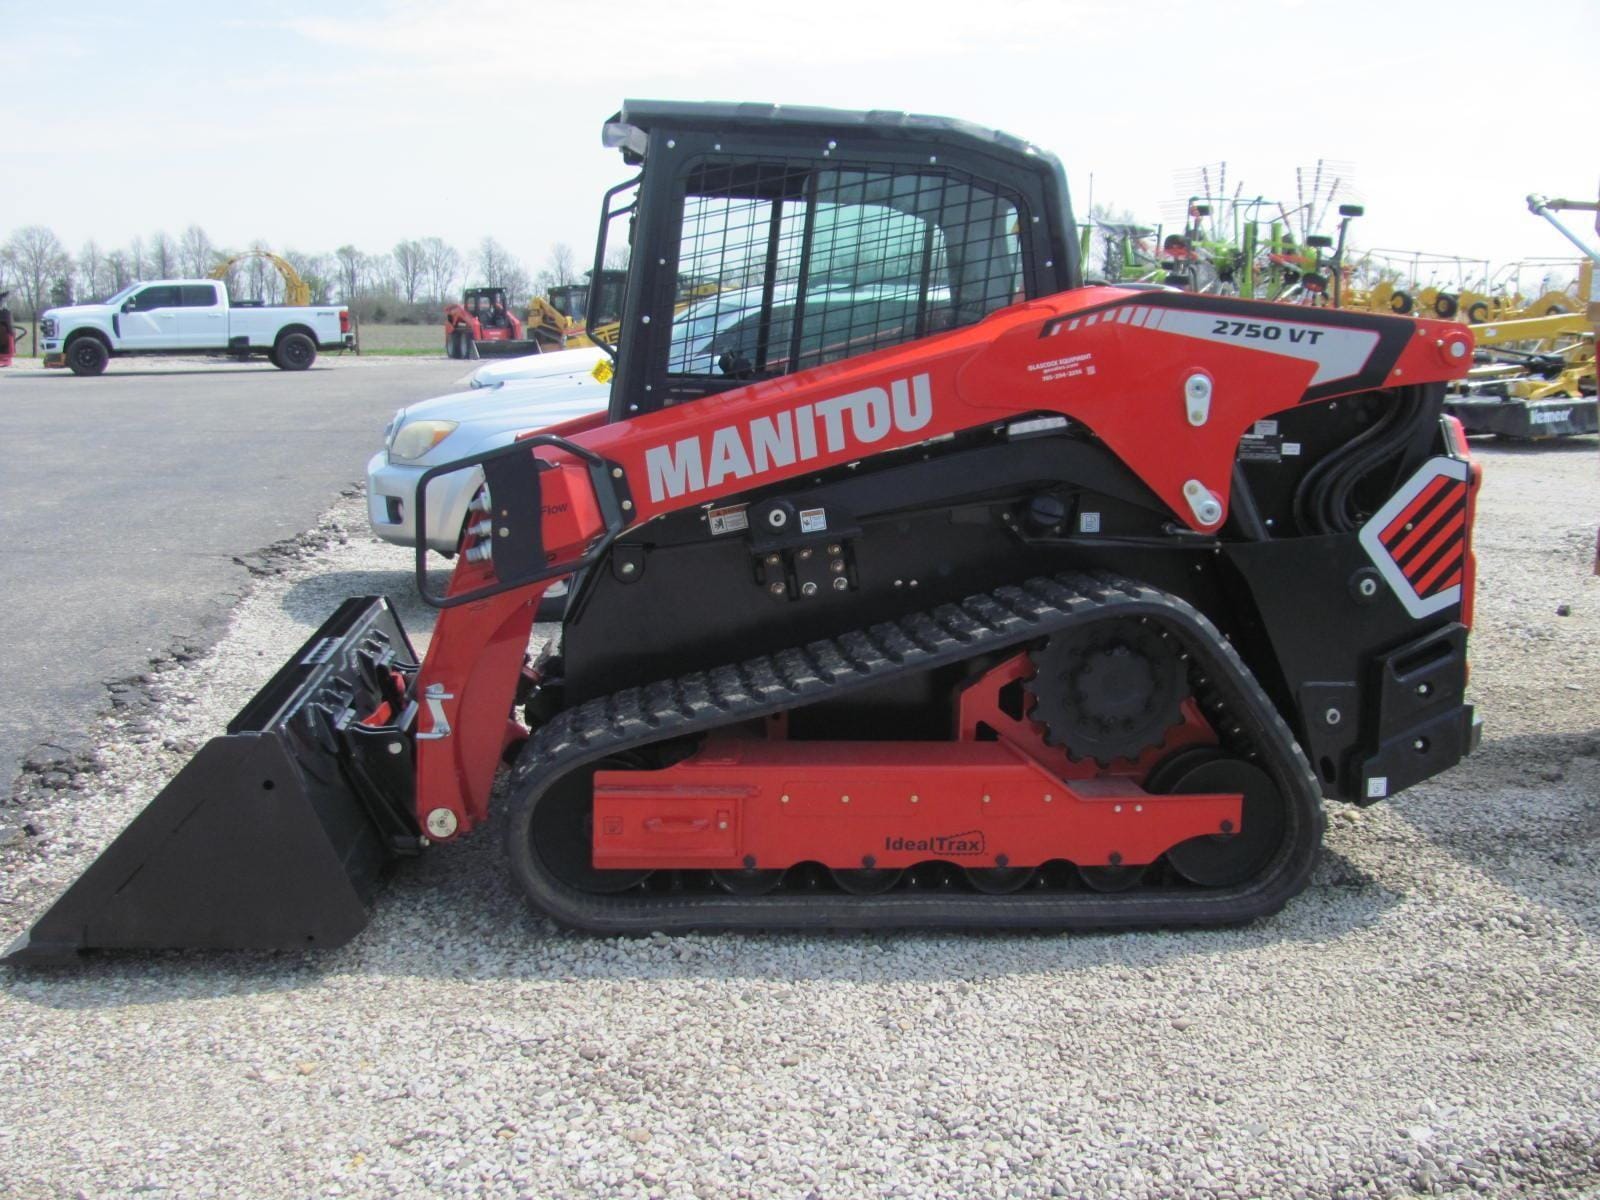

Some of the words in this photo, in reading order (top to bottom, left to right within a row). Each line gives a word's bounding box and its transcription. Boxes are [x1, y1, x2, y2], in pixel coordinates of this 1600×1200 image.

[1212, 320, 1281, 340] 2750
[1289, 328, 1324, 345] VT
[645, 373, 933, 503] MANITOU
[885, 836, 979, 851] IdealTrax
